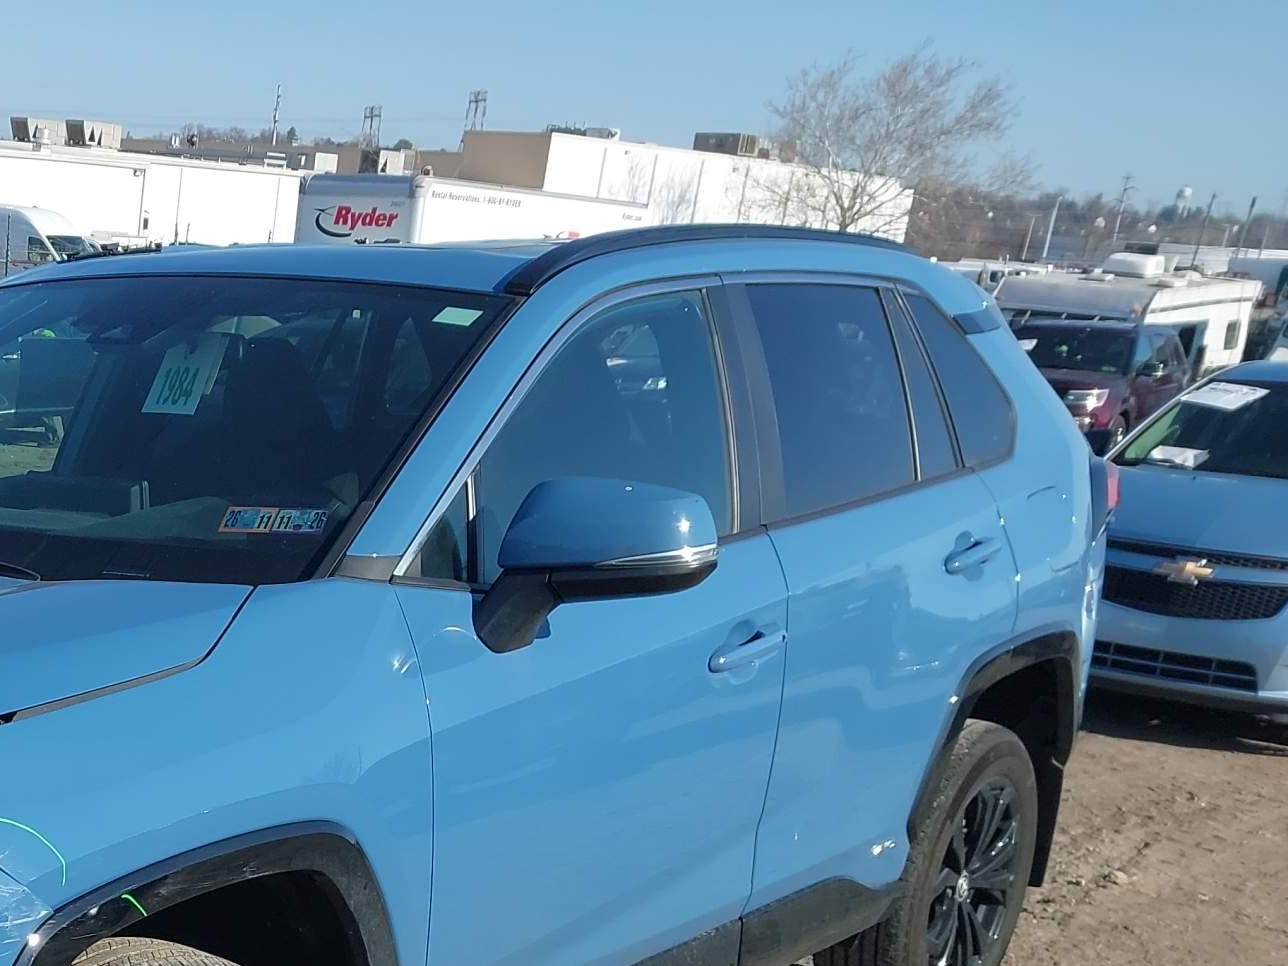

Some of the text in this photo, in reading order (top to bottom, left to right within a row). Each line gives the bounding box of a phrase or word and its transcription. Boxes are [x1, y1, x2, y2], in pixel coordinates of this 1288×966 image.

[334, 205, 399, 231] Ryder
[155, 367, 200, 406] 1984
[224, 511, 272, 529] 26 11
[277, 511, 327, 530] 11 26
